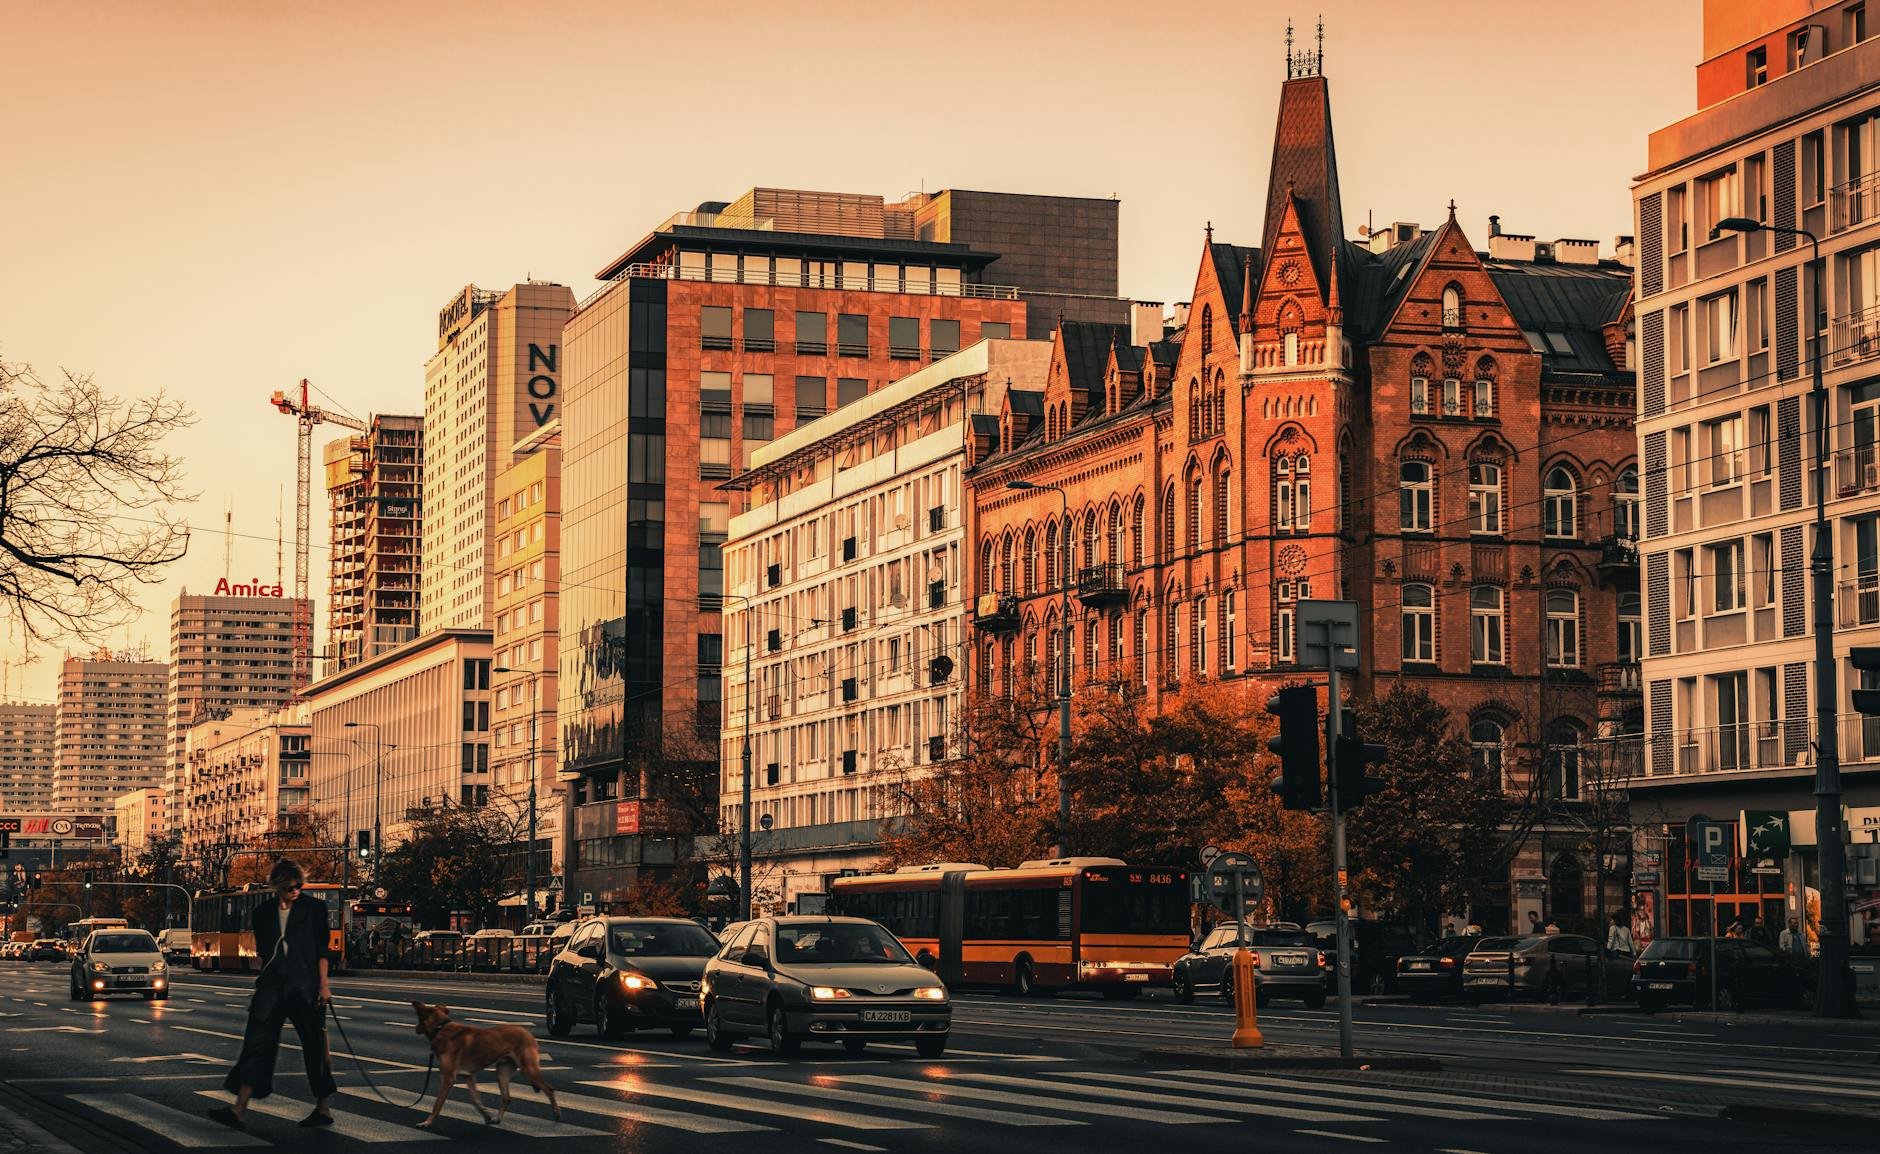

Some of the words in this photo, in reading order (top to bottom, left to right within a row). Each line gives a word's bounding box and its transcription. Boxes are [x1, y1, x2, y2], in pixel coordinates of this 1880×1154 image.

[214, 577, 283, 597] Amica
[1705, 826, 1722, 854] P
[1149, 873, 1172, 884] 8436
[583, 892, 593, 905] P
